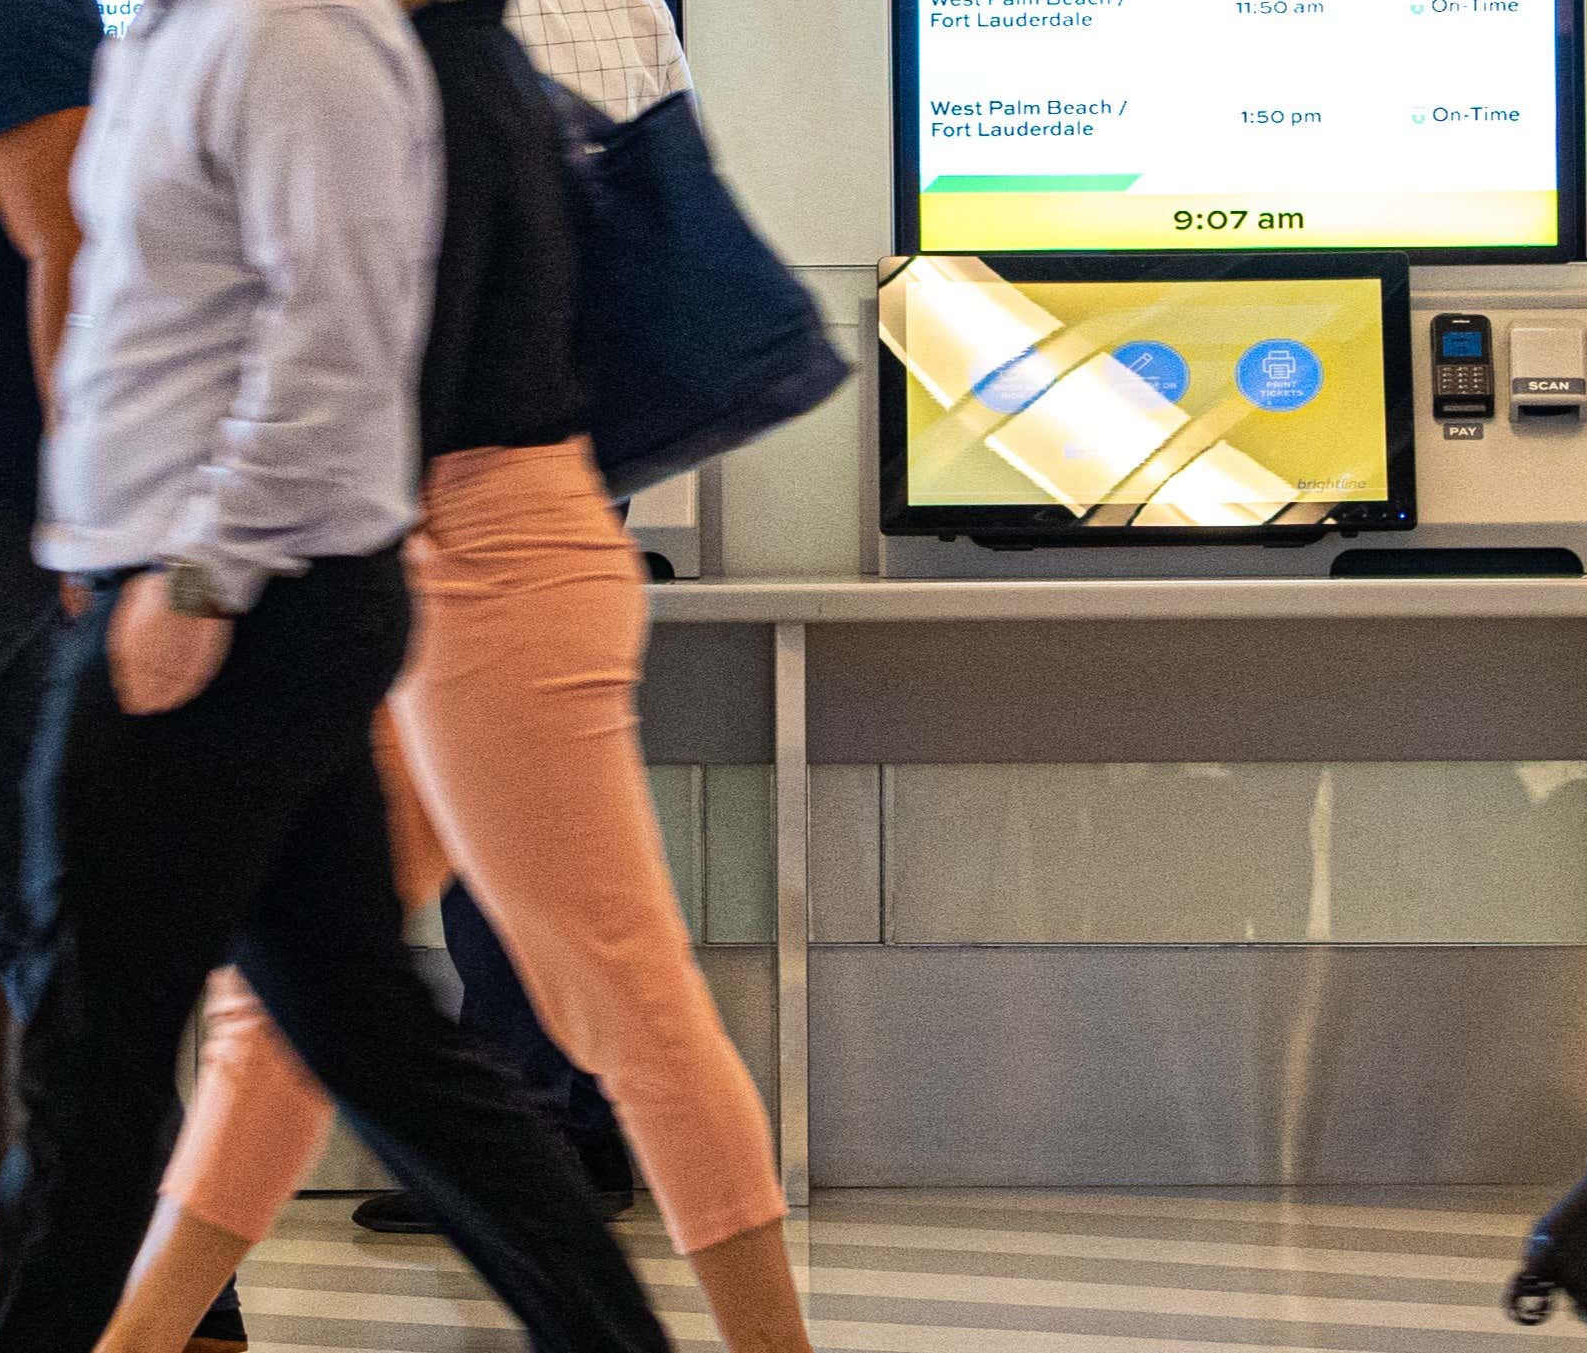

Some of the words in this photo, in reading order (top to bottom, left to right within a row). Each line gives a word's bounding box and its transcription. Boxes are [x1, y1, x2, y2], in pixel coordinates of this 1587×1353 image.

[931, 102, 982, 115] West
[990, 101, 1040, 115] Palm
[1048, 100, 1111, 114] Beach
[1119, 101, 1127, 116] /
[1433, 107, 1519, 121] On-Time
[1242, 111, 1284, 123] 1:50
[1292, 113, 1321, 126] pm
[932, 123, 971, 137] Fort
[979, 121, 1093, 136] Lauderdale
[1174, 211, 1247, 230] 9:07
[1258, 213, 1303, 229] am
[1528, 381, 1569, 390] SCAN
[1450, 427, 1477, 436] PAY
